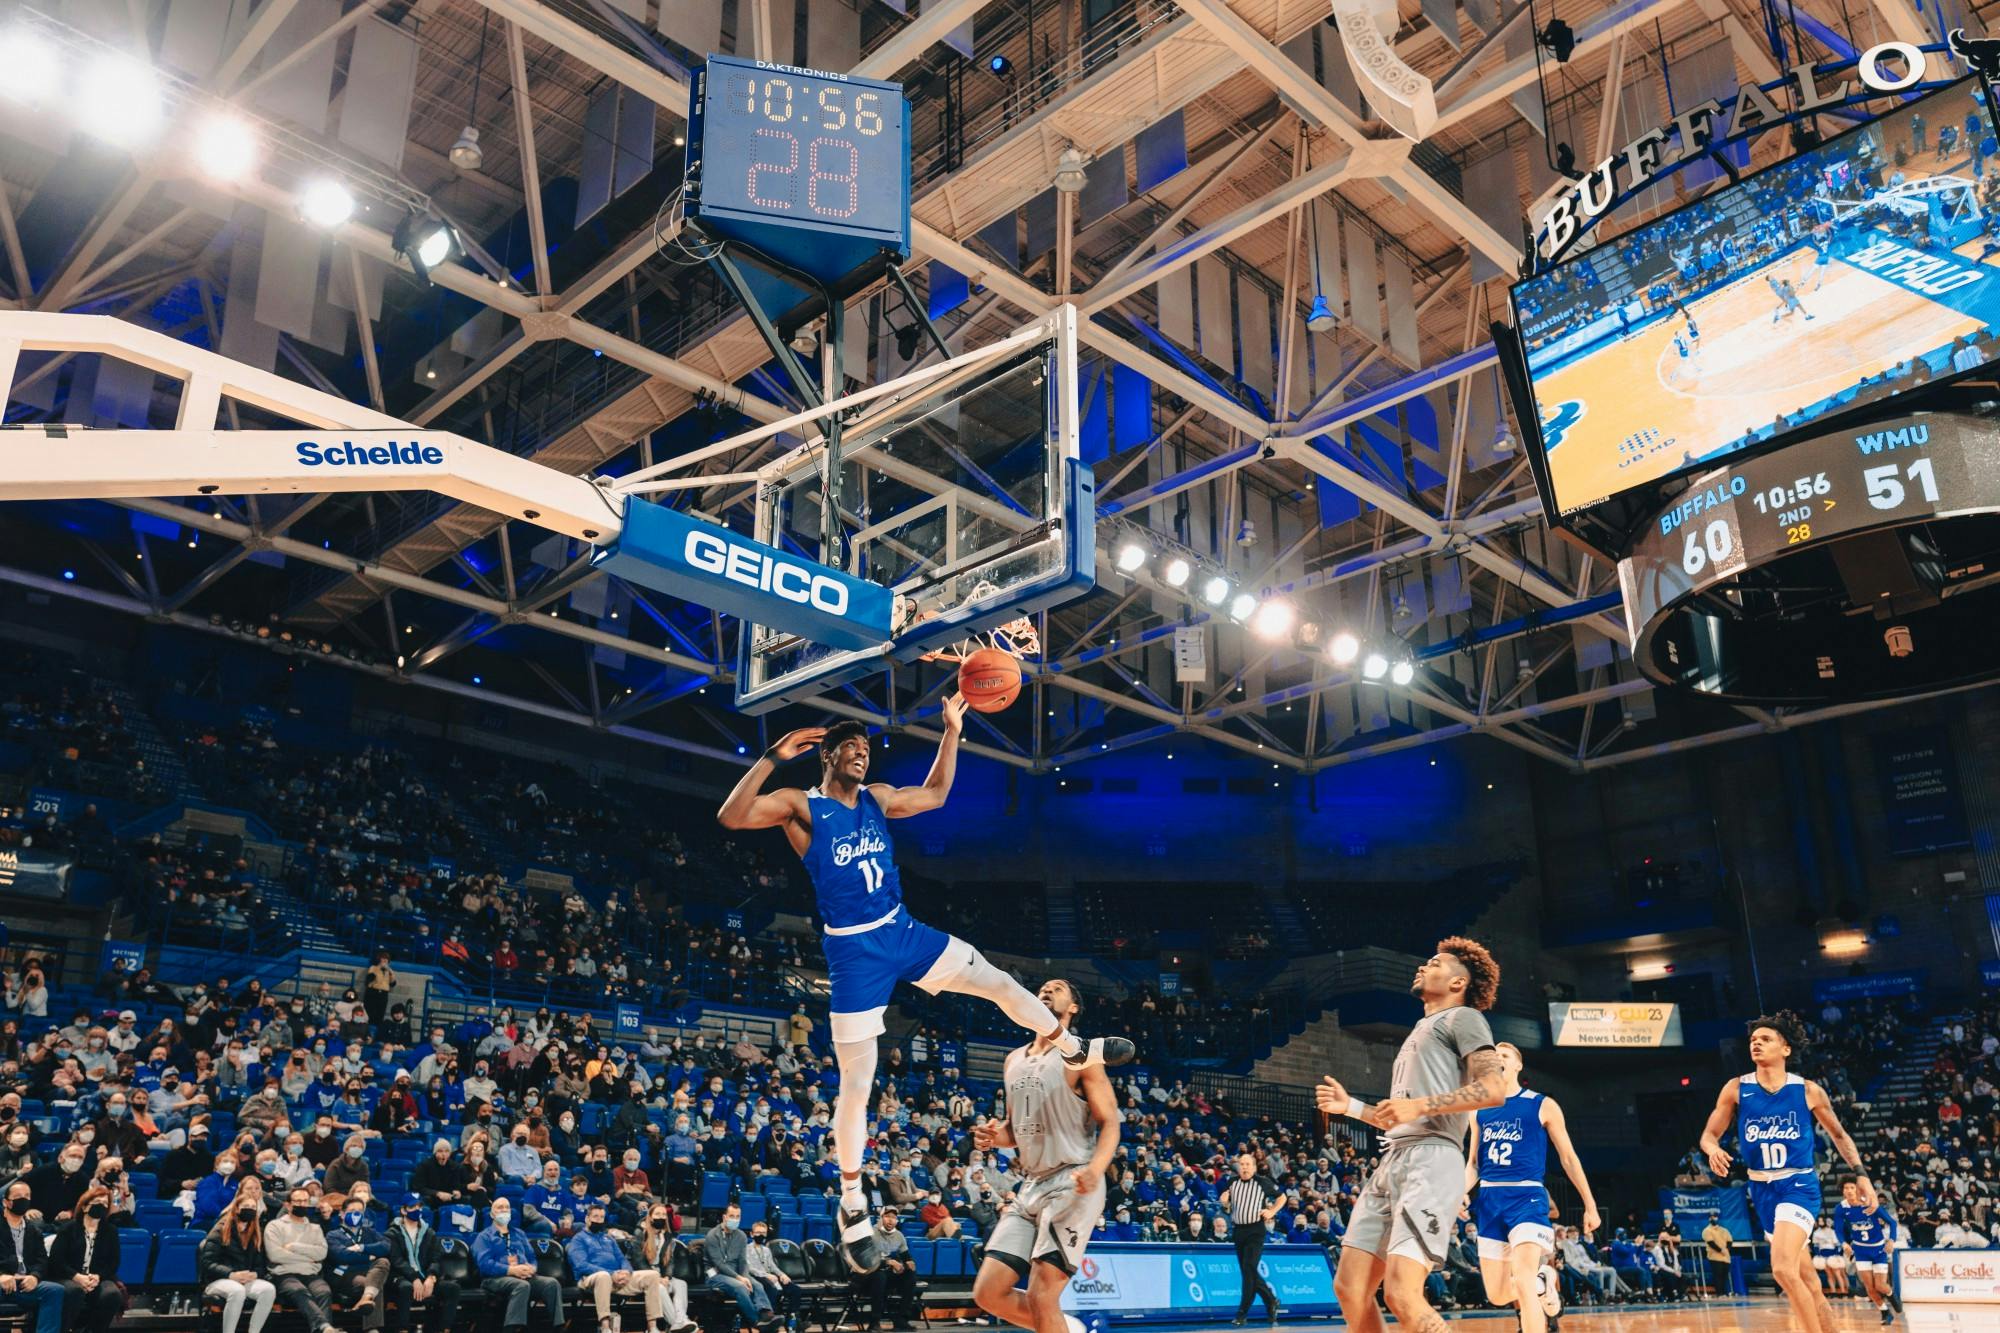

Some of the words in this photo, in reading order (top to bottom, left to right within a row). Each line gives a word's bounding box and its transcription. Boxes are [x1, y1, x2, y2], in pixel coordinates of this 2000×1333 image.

[756, 60, 848, 81] DAKTRONICS
[747, 79, 882, 136] 10:56
[1542, 41, 1927, 258] BUFFALO
[748, 128, 858, 218] 28
[1846, 240, 1985, 295] BUFFALO
[1856, 424, 1929, 455] WMU
[296, 441, 444, 466] Schelde
[1753, 472, 1831, 514] 10:56
[1863, 458, 1939, 510] 51
[1560, 496, 1611, 517] DAKTRONICS
[1659, 475, 1747, 536] BUFFALO
[1778, 506, 1811, 527] 2ND
[1787, 524, 1811, 544] 28
[1682, 519, 1733, 575] 60
[684, 530, 849, 616] GEICO
[1895, 786, 1948, 800] CHAMPIONS
[1896, 778, 1943, 791] NATIONAL
[32, 800, 59, 813] 203
[833, 836, 887, 867] Buffalo
[858, 857, 884, 894] 11
[727, 918, 742, 929] 205
[1162, 982, 1177, 990] 207
[622, 1016, 639, 1028] 103
[1578, 1034, 1610, 1043] News
[1613, 1034, 1652, 1043] Leader
[942, 1053, 956, 1063] 104
[1025, 1095, 1030, 1118] 1
[1482, 1127, 1521, 1143] Buffalo
[1744, 1124, 1801, 1142] Buffalo
[1487, 1141, 1513, 1166] 42
[1760, 1142, 1788, 1169] 10
[1860, 1230, 1870, 1241] 3
[1904, 1262, 1945, 1277] Castle
[1951, 1262, 1994, 1277] Castle
[1072, 1280, 1116, 1294] ComDoc
